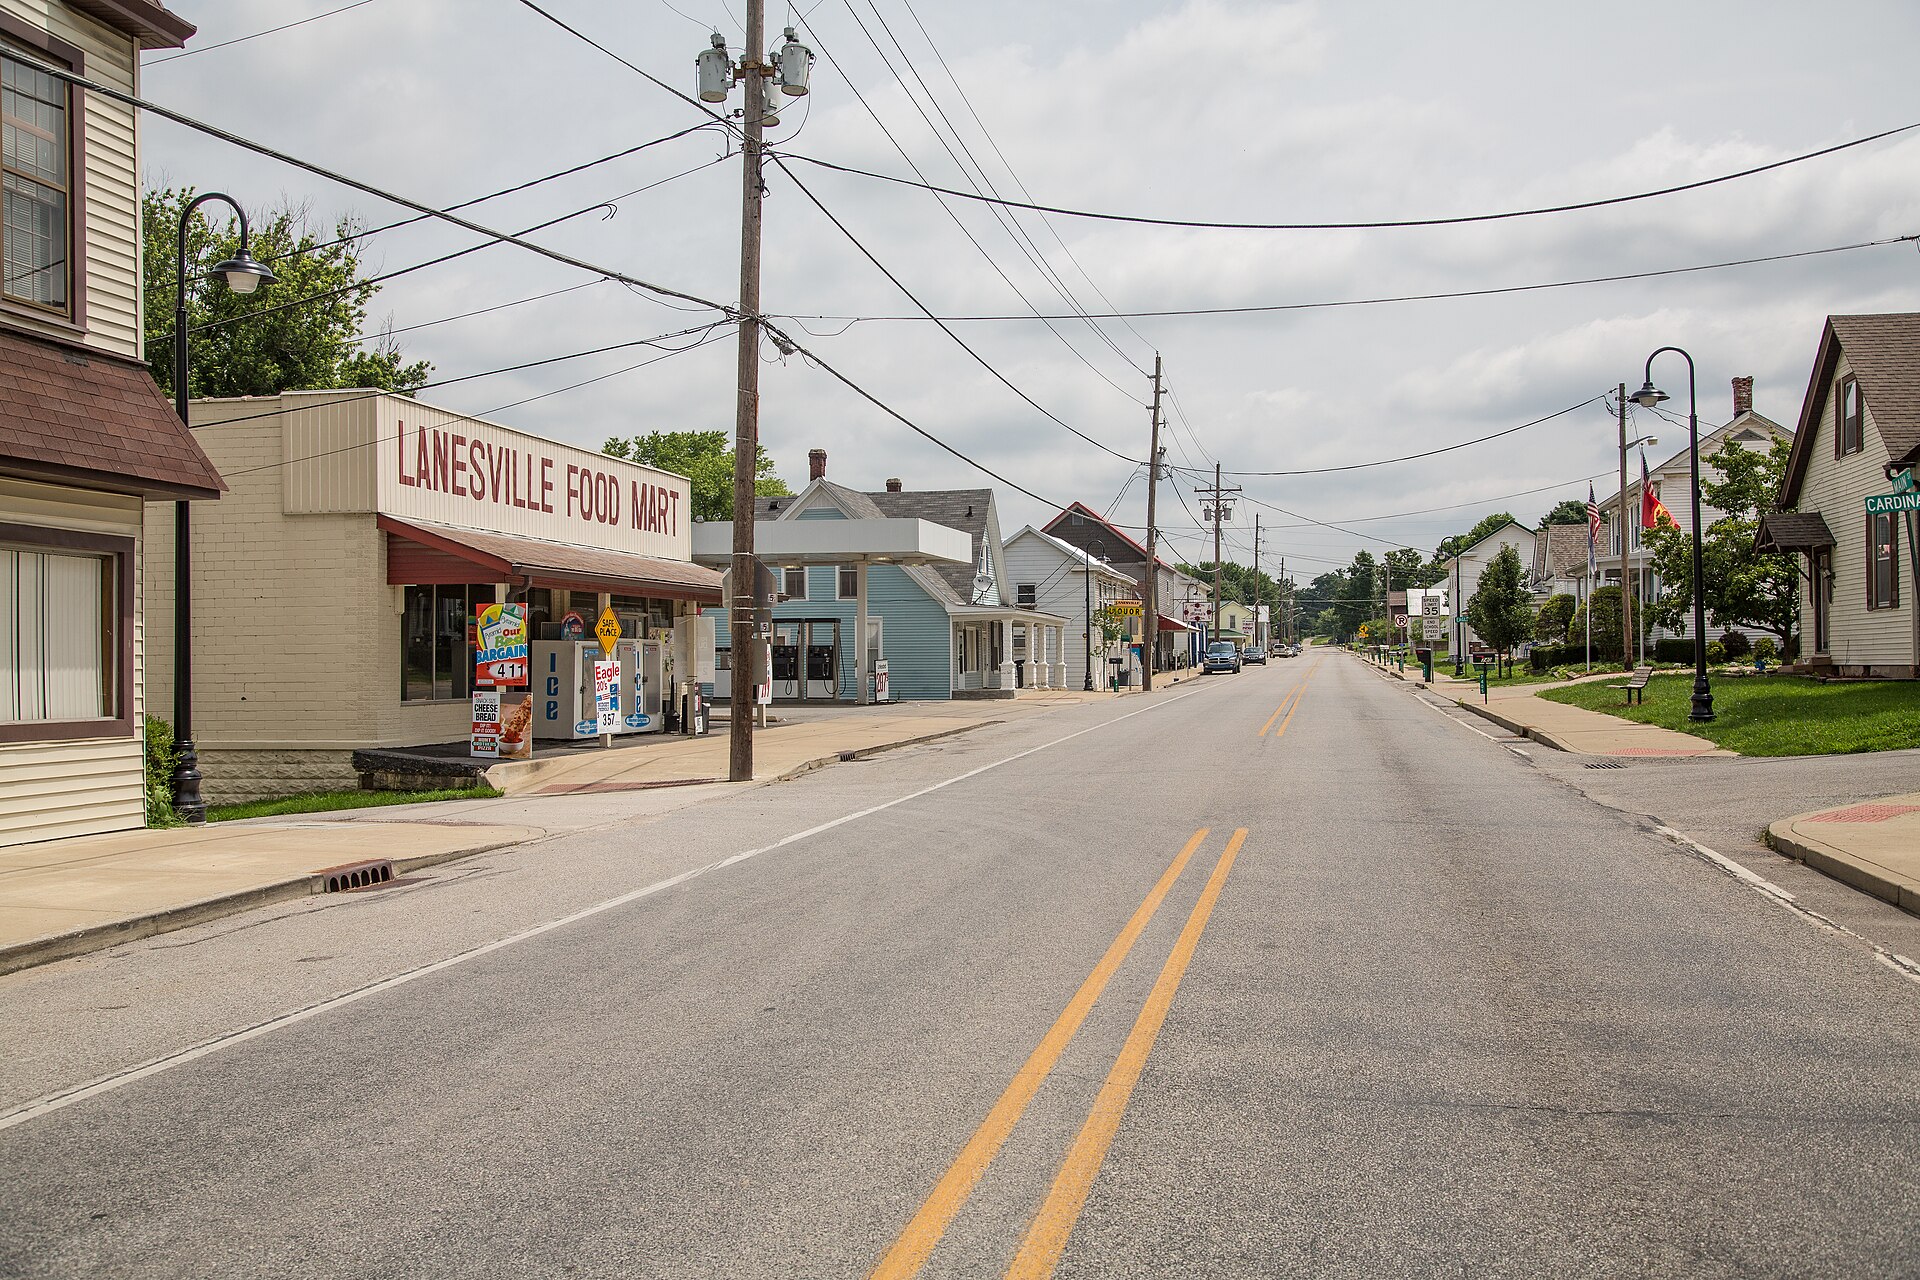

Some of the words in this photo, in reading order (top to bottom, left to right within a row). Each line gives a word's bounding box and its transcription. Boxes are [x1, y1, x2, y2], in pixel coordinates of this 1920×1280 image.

[398, 419, 553, 514] LANESVILLE
[567, 463, 620, 526] FOOD
[632, 480, 680, 537] MART
[1893, 477, 1908, 494] MAIN
[1423, 607, 1438, 616] 35
[602, 619, 615, 627] SAFE
[502, 628, 521, 637] Our
[600, 628, 617, 636] PLACE
[476, 645, 527, 663] BARGAIN
[498, 663, 524, 679] 4.11
[595, 662, 620, 682] Eagle
[597, 681, 608, 691] 20's
[474, 704, 498, 712] CHEESE
[475, 713, 496, 721] BREAD
